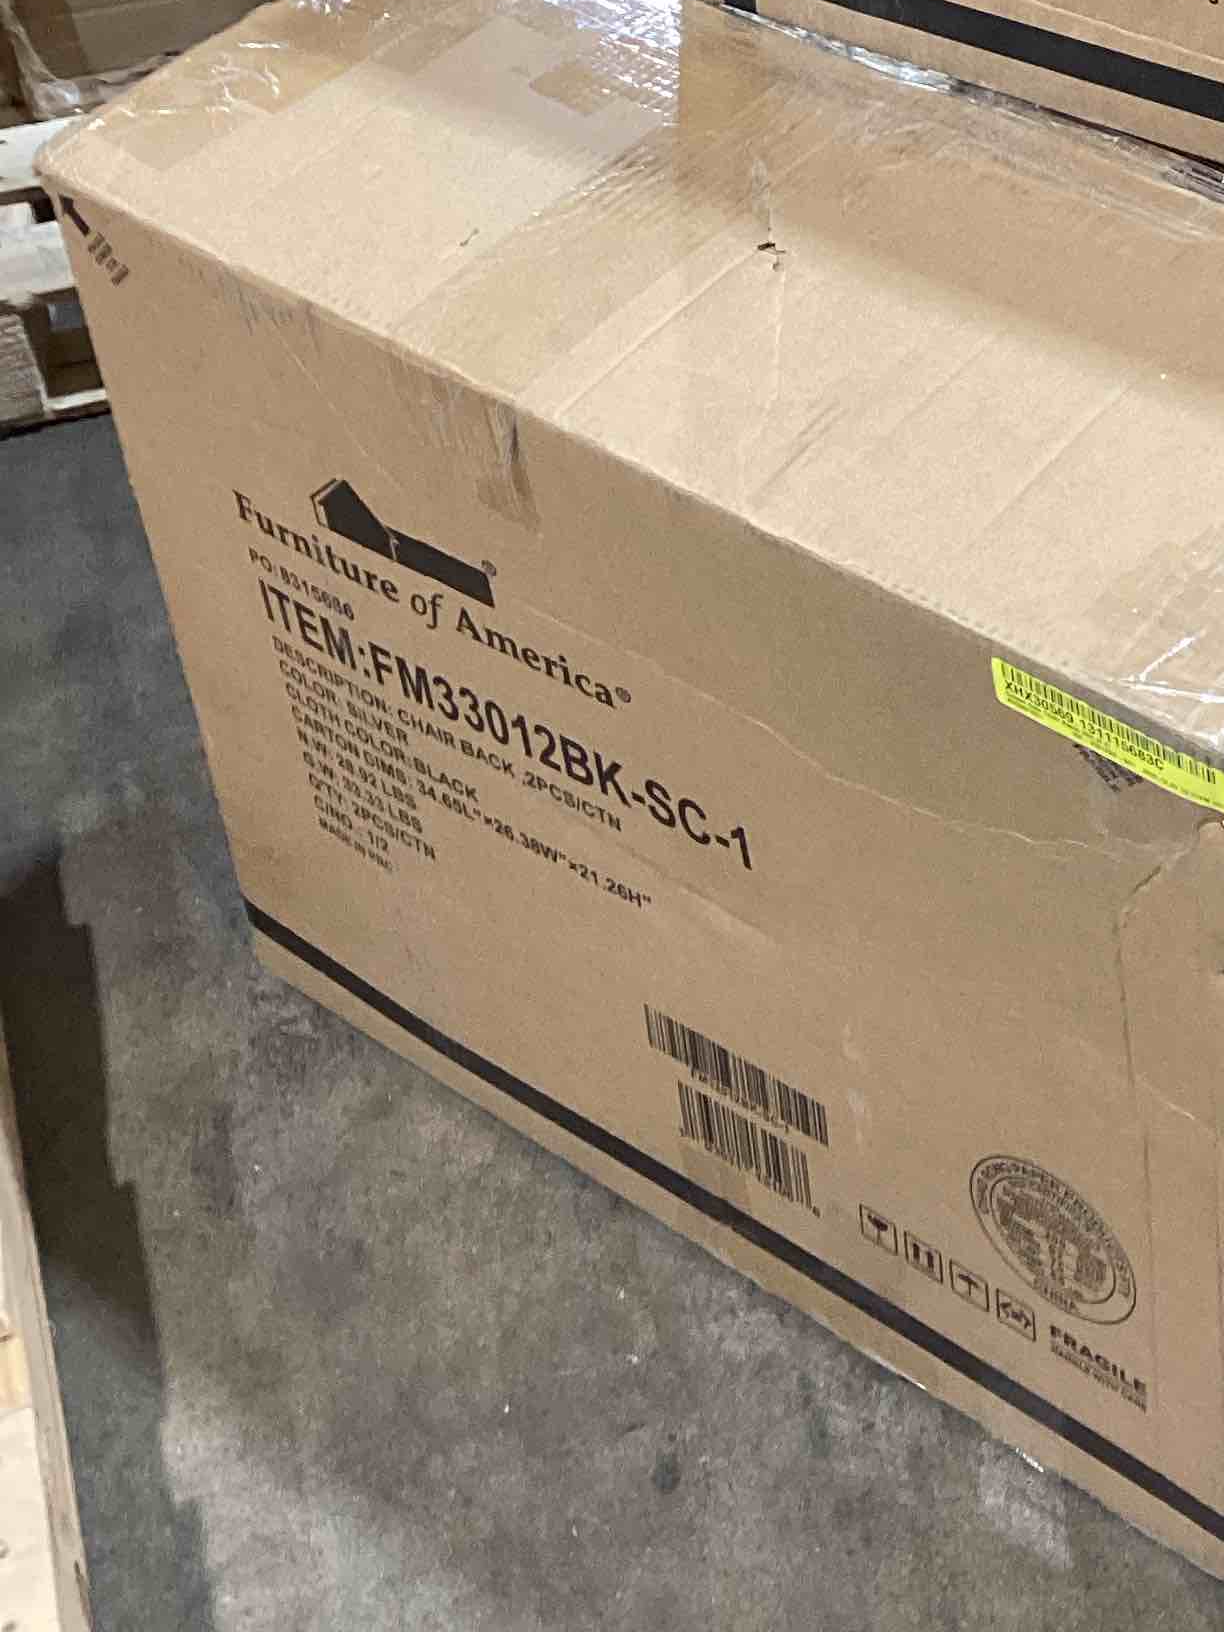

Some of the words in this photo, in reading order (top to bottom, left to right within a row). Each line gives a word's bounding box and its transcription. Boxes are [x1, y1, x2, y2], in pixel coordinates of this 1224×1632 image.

[233, 489, 400, 604] Furniture
[410, 590, 444, 630] of
[259, 578, 753, 870] ITEM:FM33012BK-SC-1
[397, 707, 456, 748] CHAIR
[460, 737, 515, 778] BACK
